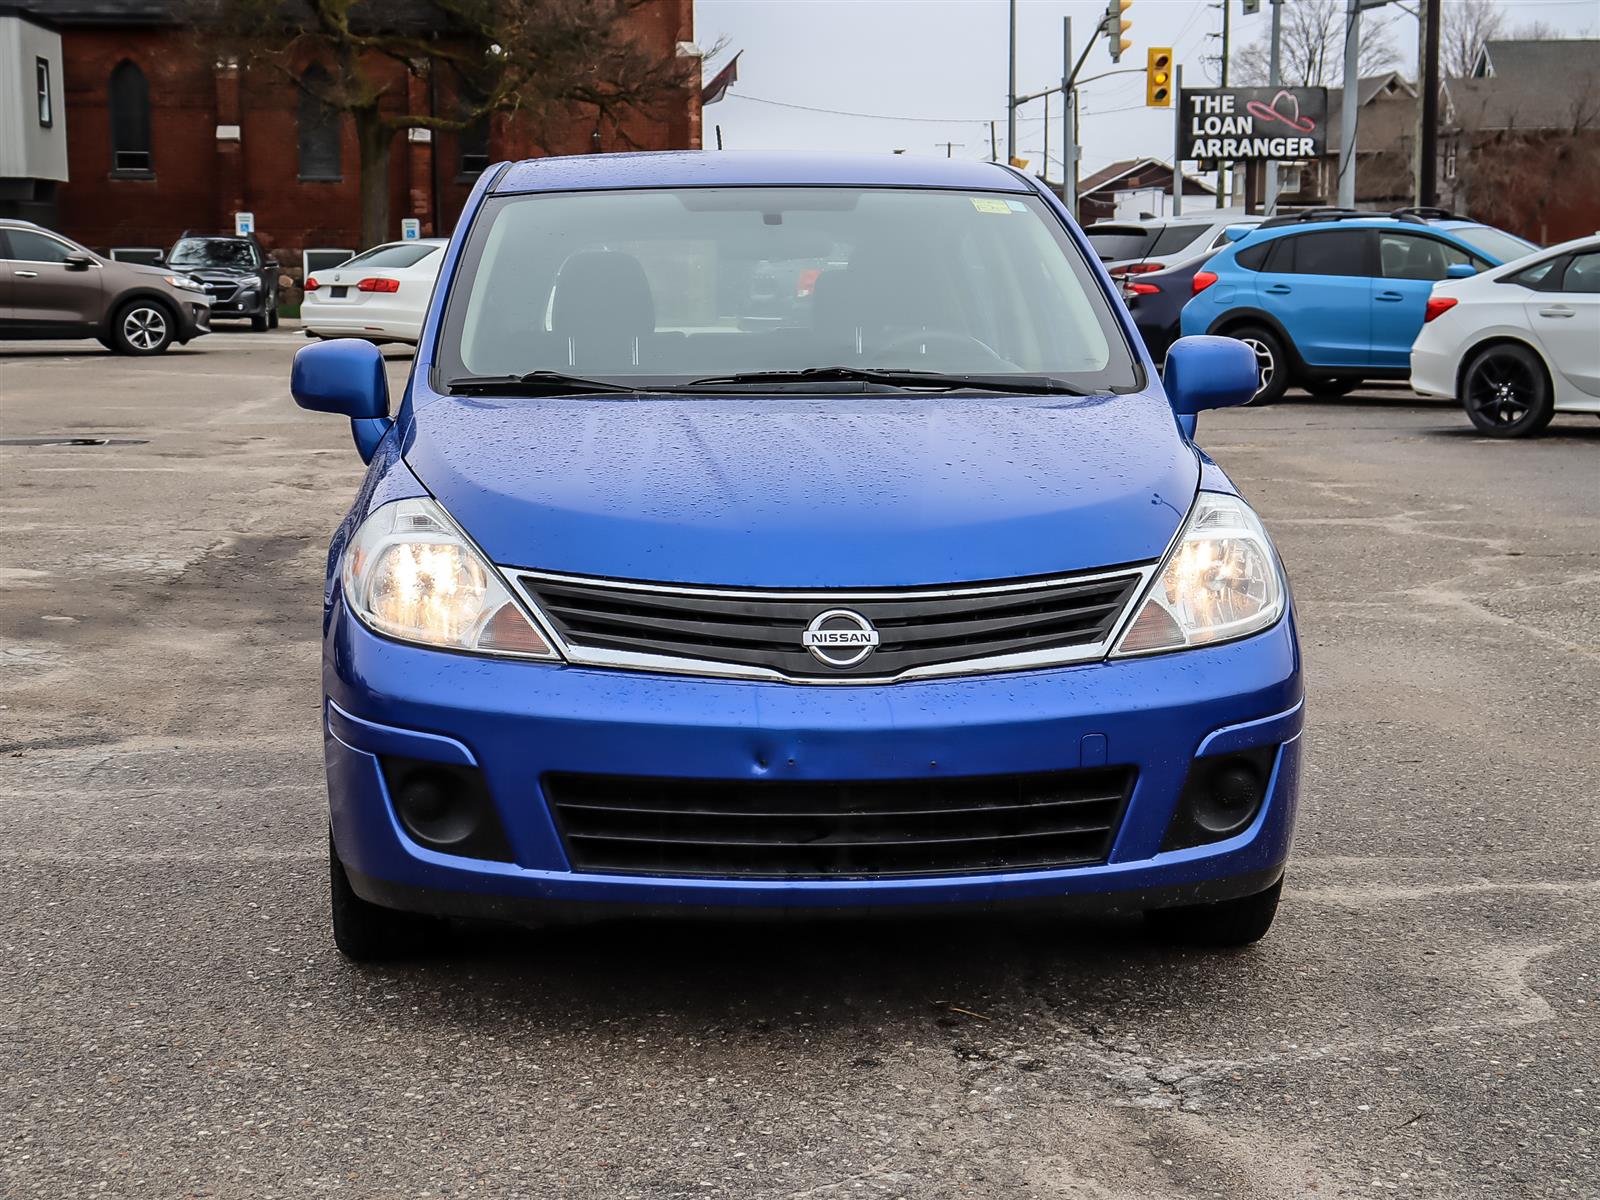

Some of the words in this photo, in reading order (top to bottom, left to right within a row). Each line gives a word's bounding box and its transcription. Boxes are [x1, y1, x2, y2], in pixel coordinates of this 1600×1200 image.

[1190, 95, 1235, 114] THE
[1192, 116, 1253, 135] LOAN
[1190, 137, 1315, 158] ARRANGER
[811, 633, 871, 643] NISSAN
